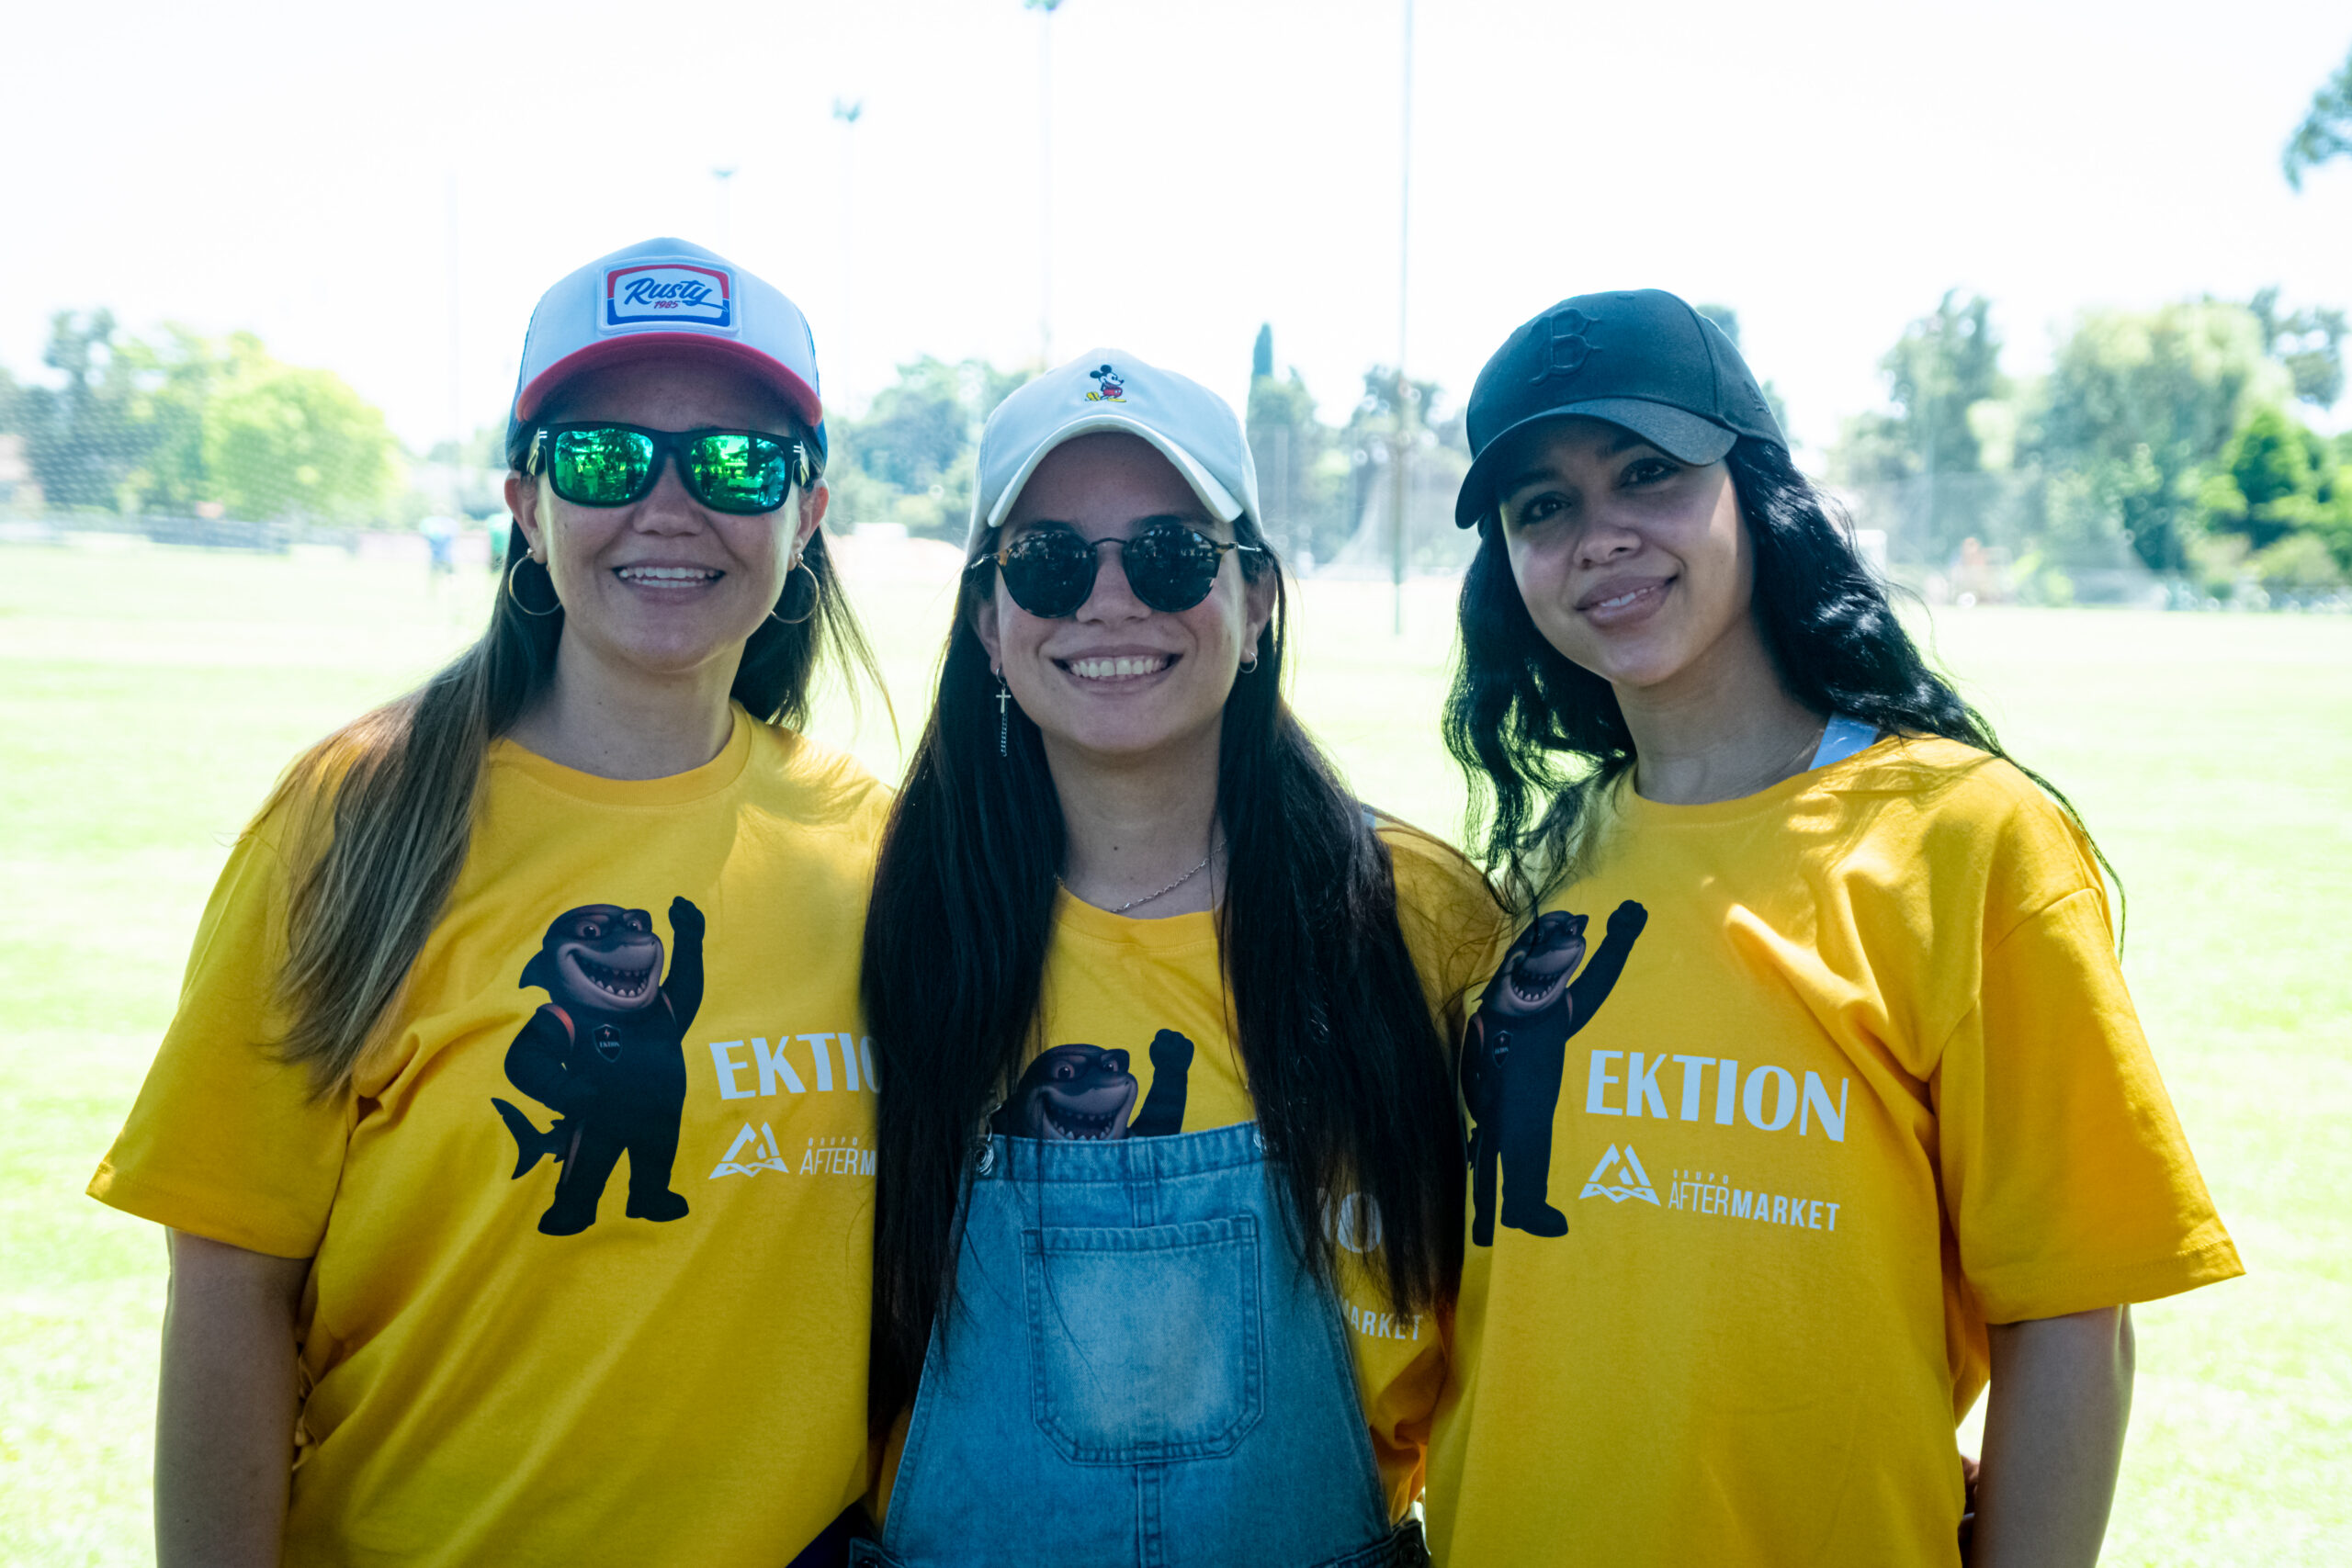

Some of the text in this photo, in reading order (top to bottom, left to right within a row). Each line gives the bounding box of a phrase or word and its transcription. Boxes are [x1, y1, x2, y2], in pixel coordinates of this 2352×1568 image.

[624, 277, 728, 312] Rusty
[653, 300, 679, 310] 1985
[1586, 1049, 1849, 1143] EKTION
[1668, 1181, 1840, 1232] AFTERMARKET
